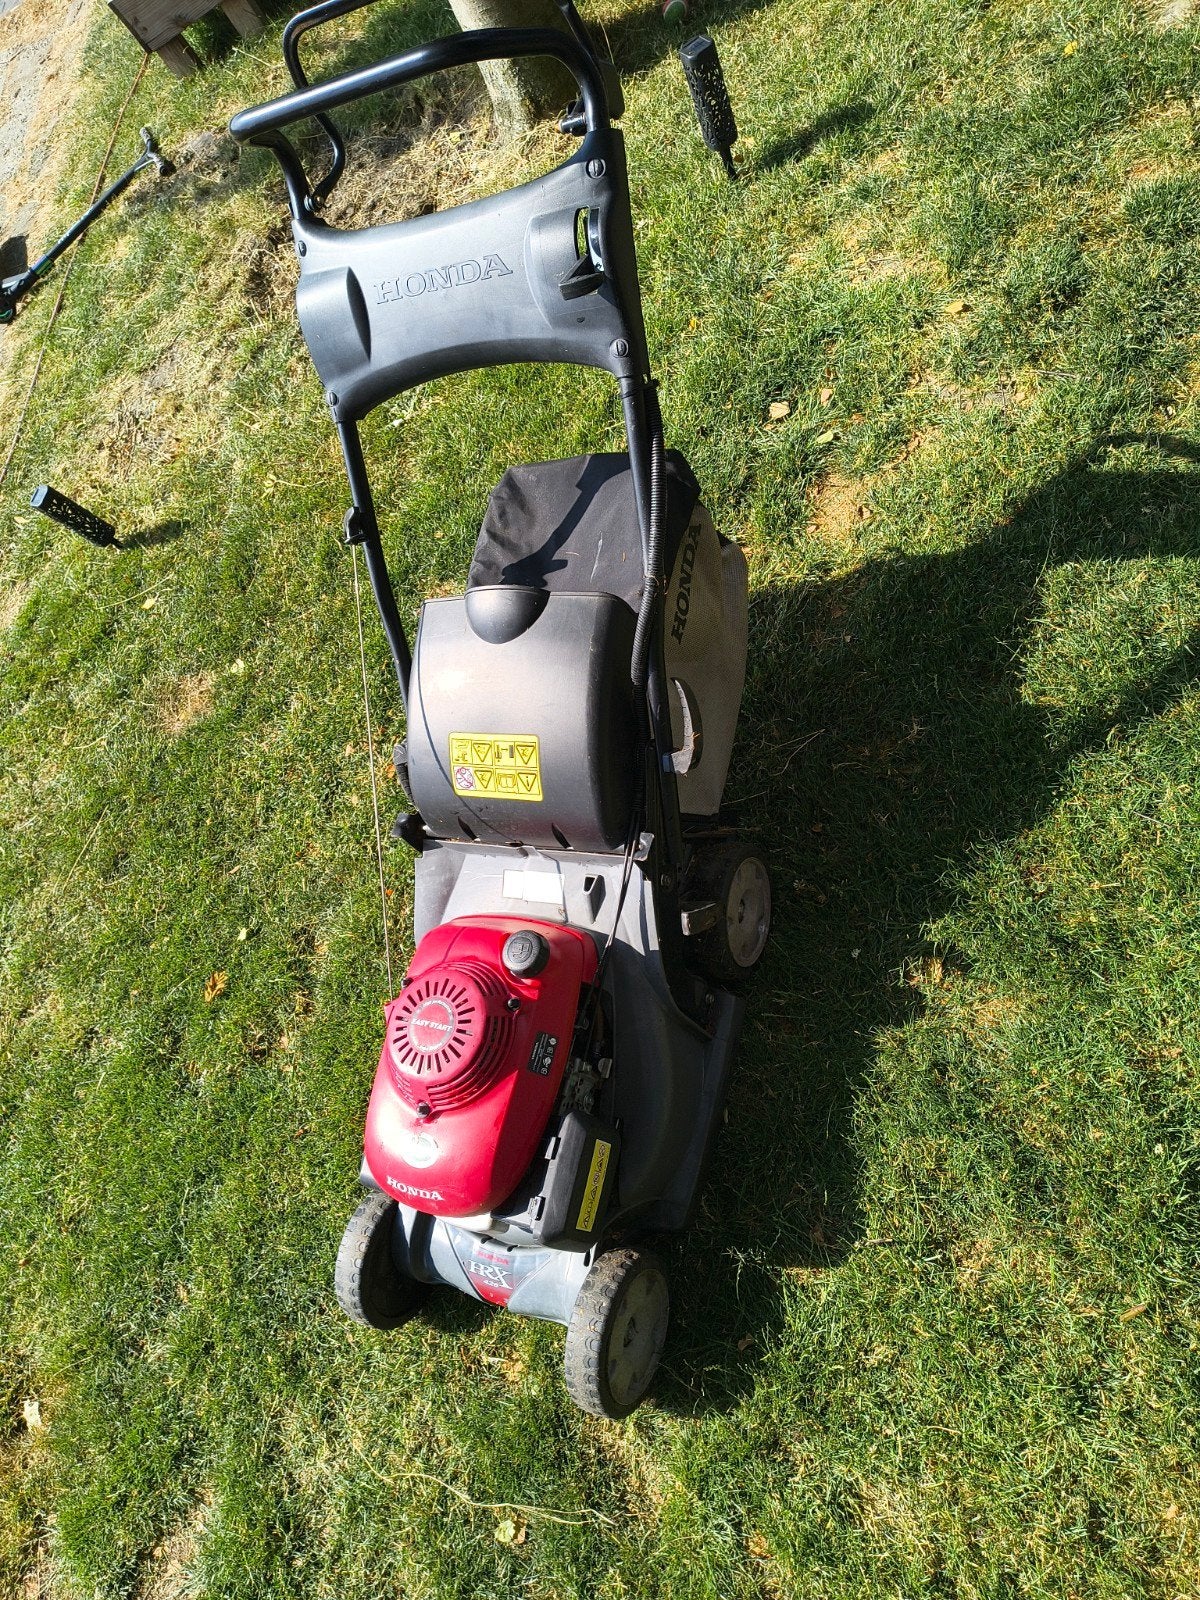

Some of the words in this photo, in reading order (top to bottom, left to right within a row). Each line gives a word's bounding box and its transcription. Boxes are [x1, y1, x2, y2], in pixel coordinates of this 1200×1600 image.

[373, 253, 514, 305] HONDA
[670, 523, 702, 645] HONDA
[410, 1018, 431, 1028] EASY
[428, 1020, 453, 1032] START
[386, 1174, 445, 1201] HONDA
[468, 1259, 514, 1290] HRX
